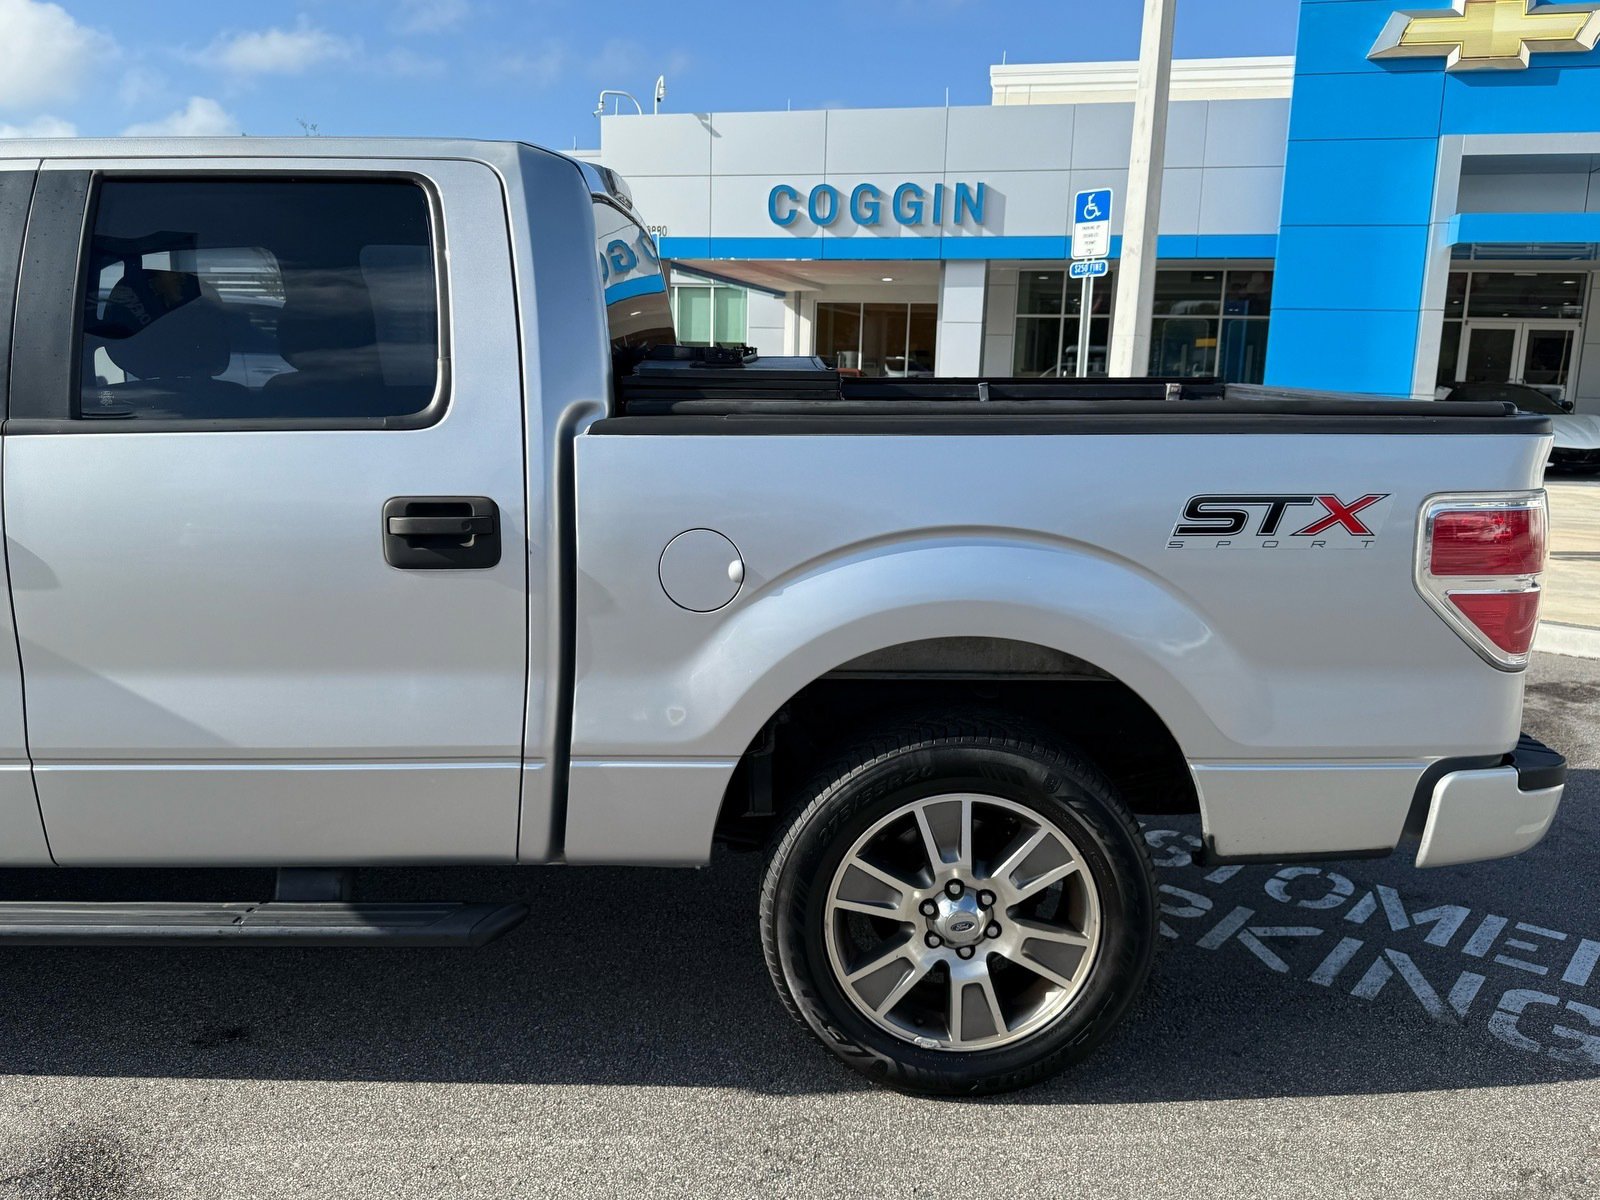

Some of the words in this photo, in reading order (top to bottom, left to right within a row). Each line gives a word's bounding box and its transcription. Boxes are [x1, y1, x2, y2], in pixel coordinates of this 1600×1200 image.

[768, 182, 985, 226] COGGIN
[1173, 493, 1392, 536] STX
[1167, 540, 1375, 549] SPORT
